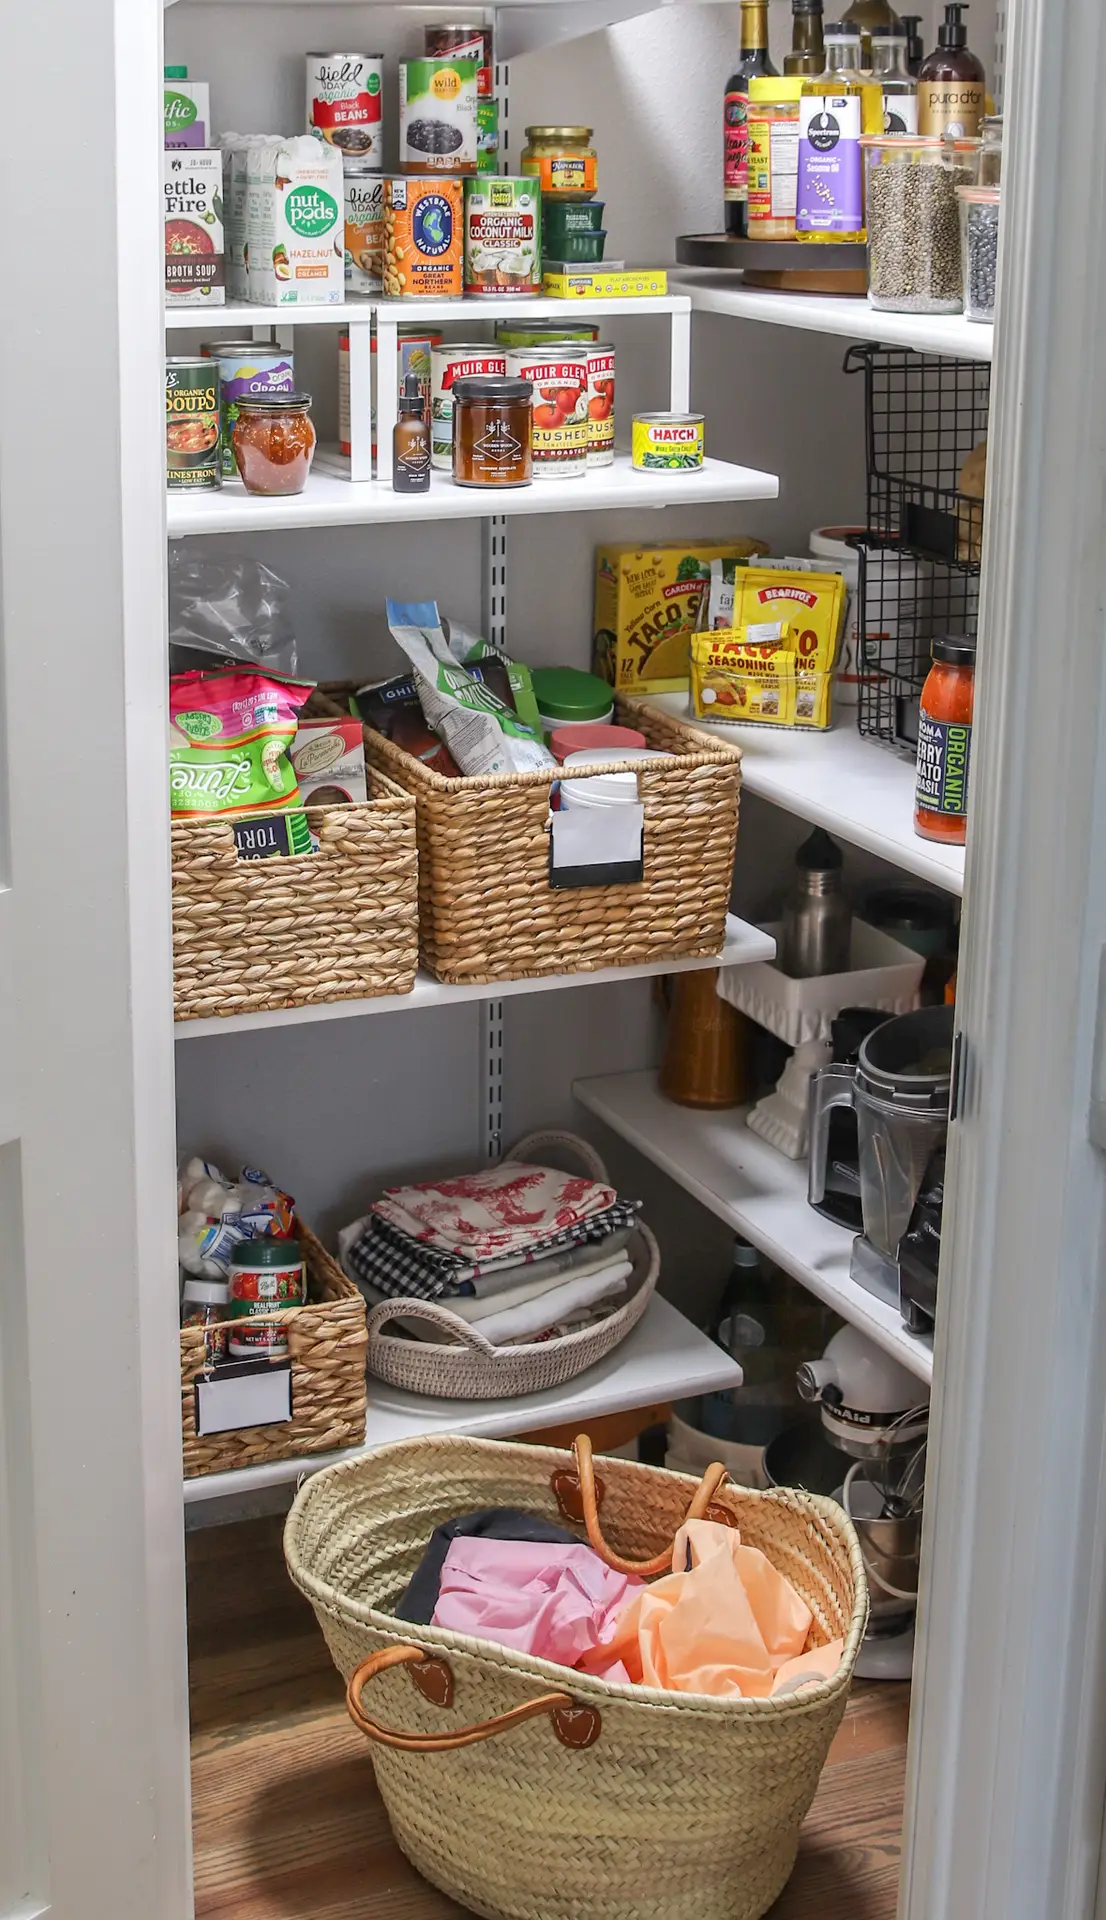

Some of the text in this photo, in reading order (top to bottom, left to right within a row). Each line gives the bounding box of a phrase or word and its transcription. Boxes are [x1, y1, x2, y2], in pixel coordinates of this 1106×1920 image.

[315, 62, 362, 89] field
[434, 76, 457, 88] wild
[327, 82, 346, 90] DAY
[929, 92, 958, 108] pura
[334, 109, 368, 122] BEANS
[166, 196, 206, 212] Fire
[290, 192, 320, 207] nut
[290, 200, 334, 226] pods
[416, 198, 451, 217] WESTBRAE
[480, 217, 523, 226] ORGANIC
[470, 226, 533, 238] COCONUT MILK
[290, 249, 332, 258] HAZELNUT
[166, 264, 216, 277] BROTH SOUP
[452, 362, 482, 377] MUIR
[526, 367, 585, 380] MUIR GLEN
[533, 430, 586, 442] RUSHED
[653, 429, 694, 440] HATCH
[664, 583, 695, 596] GARDEN
[766, 589, 811, 602] BEARITOS
[624, 601, 661, 633] Yellow Corn
[628, 603, 682, 652] TACO
[621, 658, 634, 672] 12
[707, 655, 775, 671] SEASONING
[944, 728, 966, 811] ORGANIC
[170, 760, 251, 799] Lime
[172, 799, 219, 807] SQUEEZE
